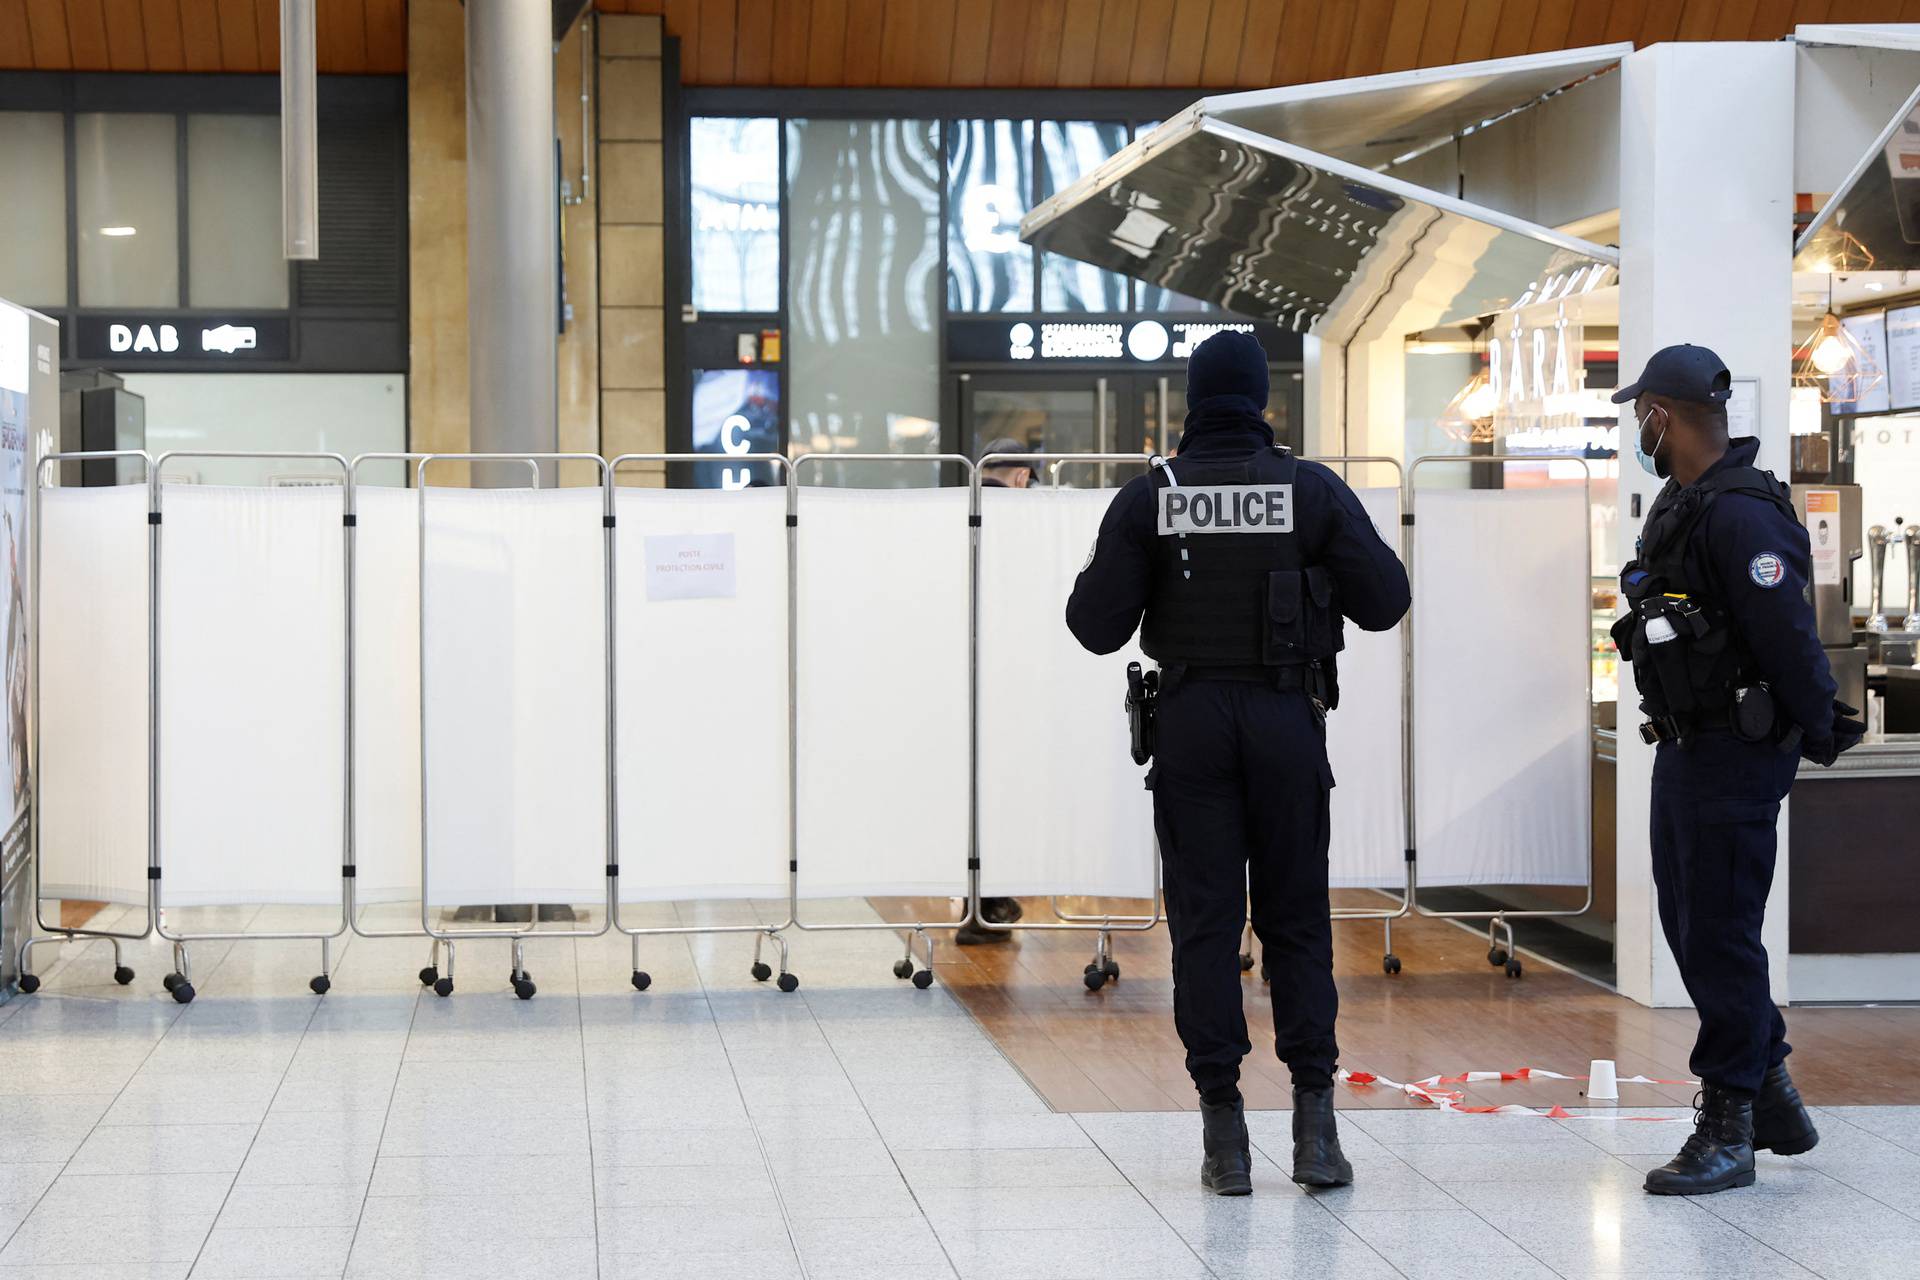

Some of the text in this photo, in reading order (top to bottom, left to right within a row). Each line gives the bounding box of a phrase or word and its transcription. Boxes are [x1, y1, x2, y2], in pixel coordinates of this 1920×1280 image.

[109, 324, 179, 352] DAB
[1166, 491, 1285, 528] POLICE
[678, 550, 701, 559] POSTE
[655, 563, 724, 573] PROTECTION CIVILE
